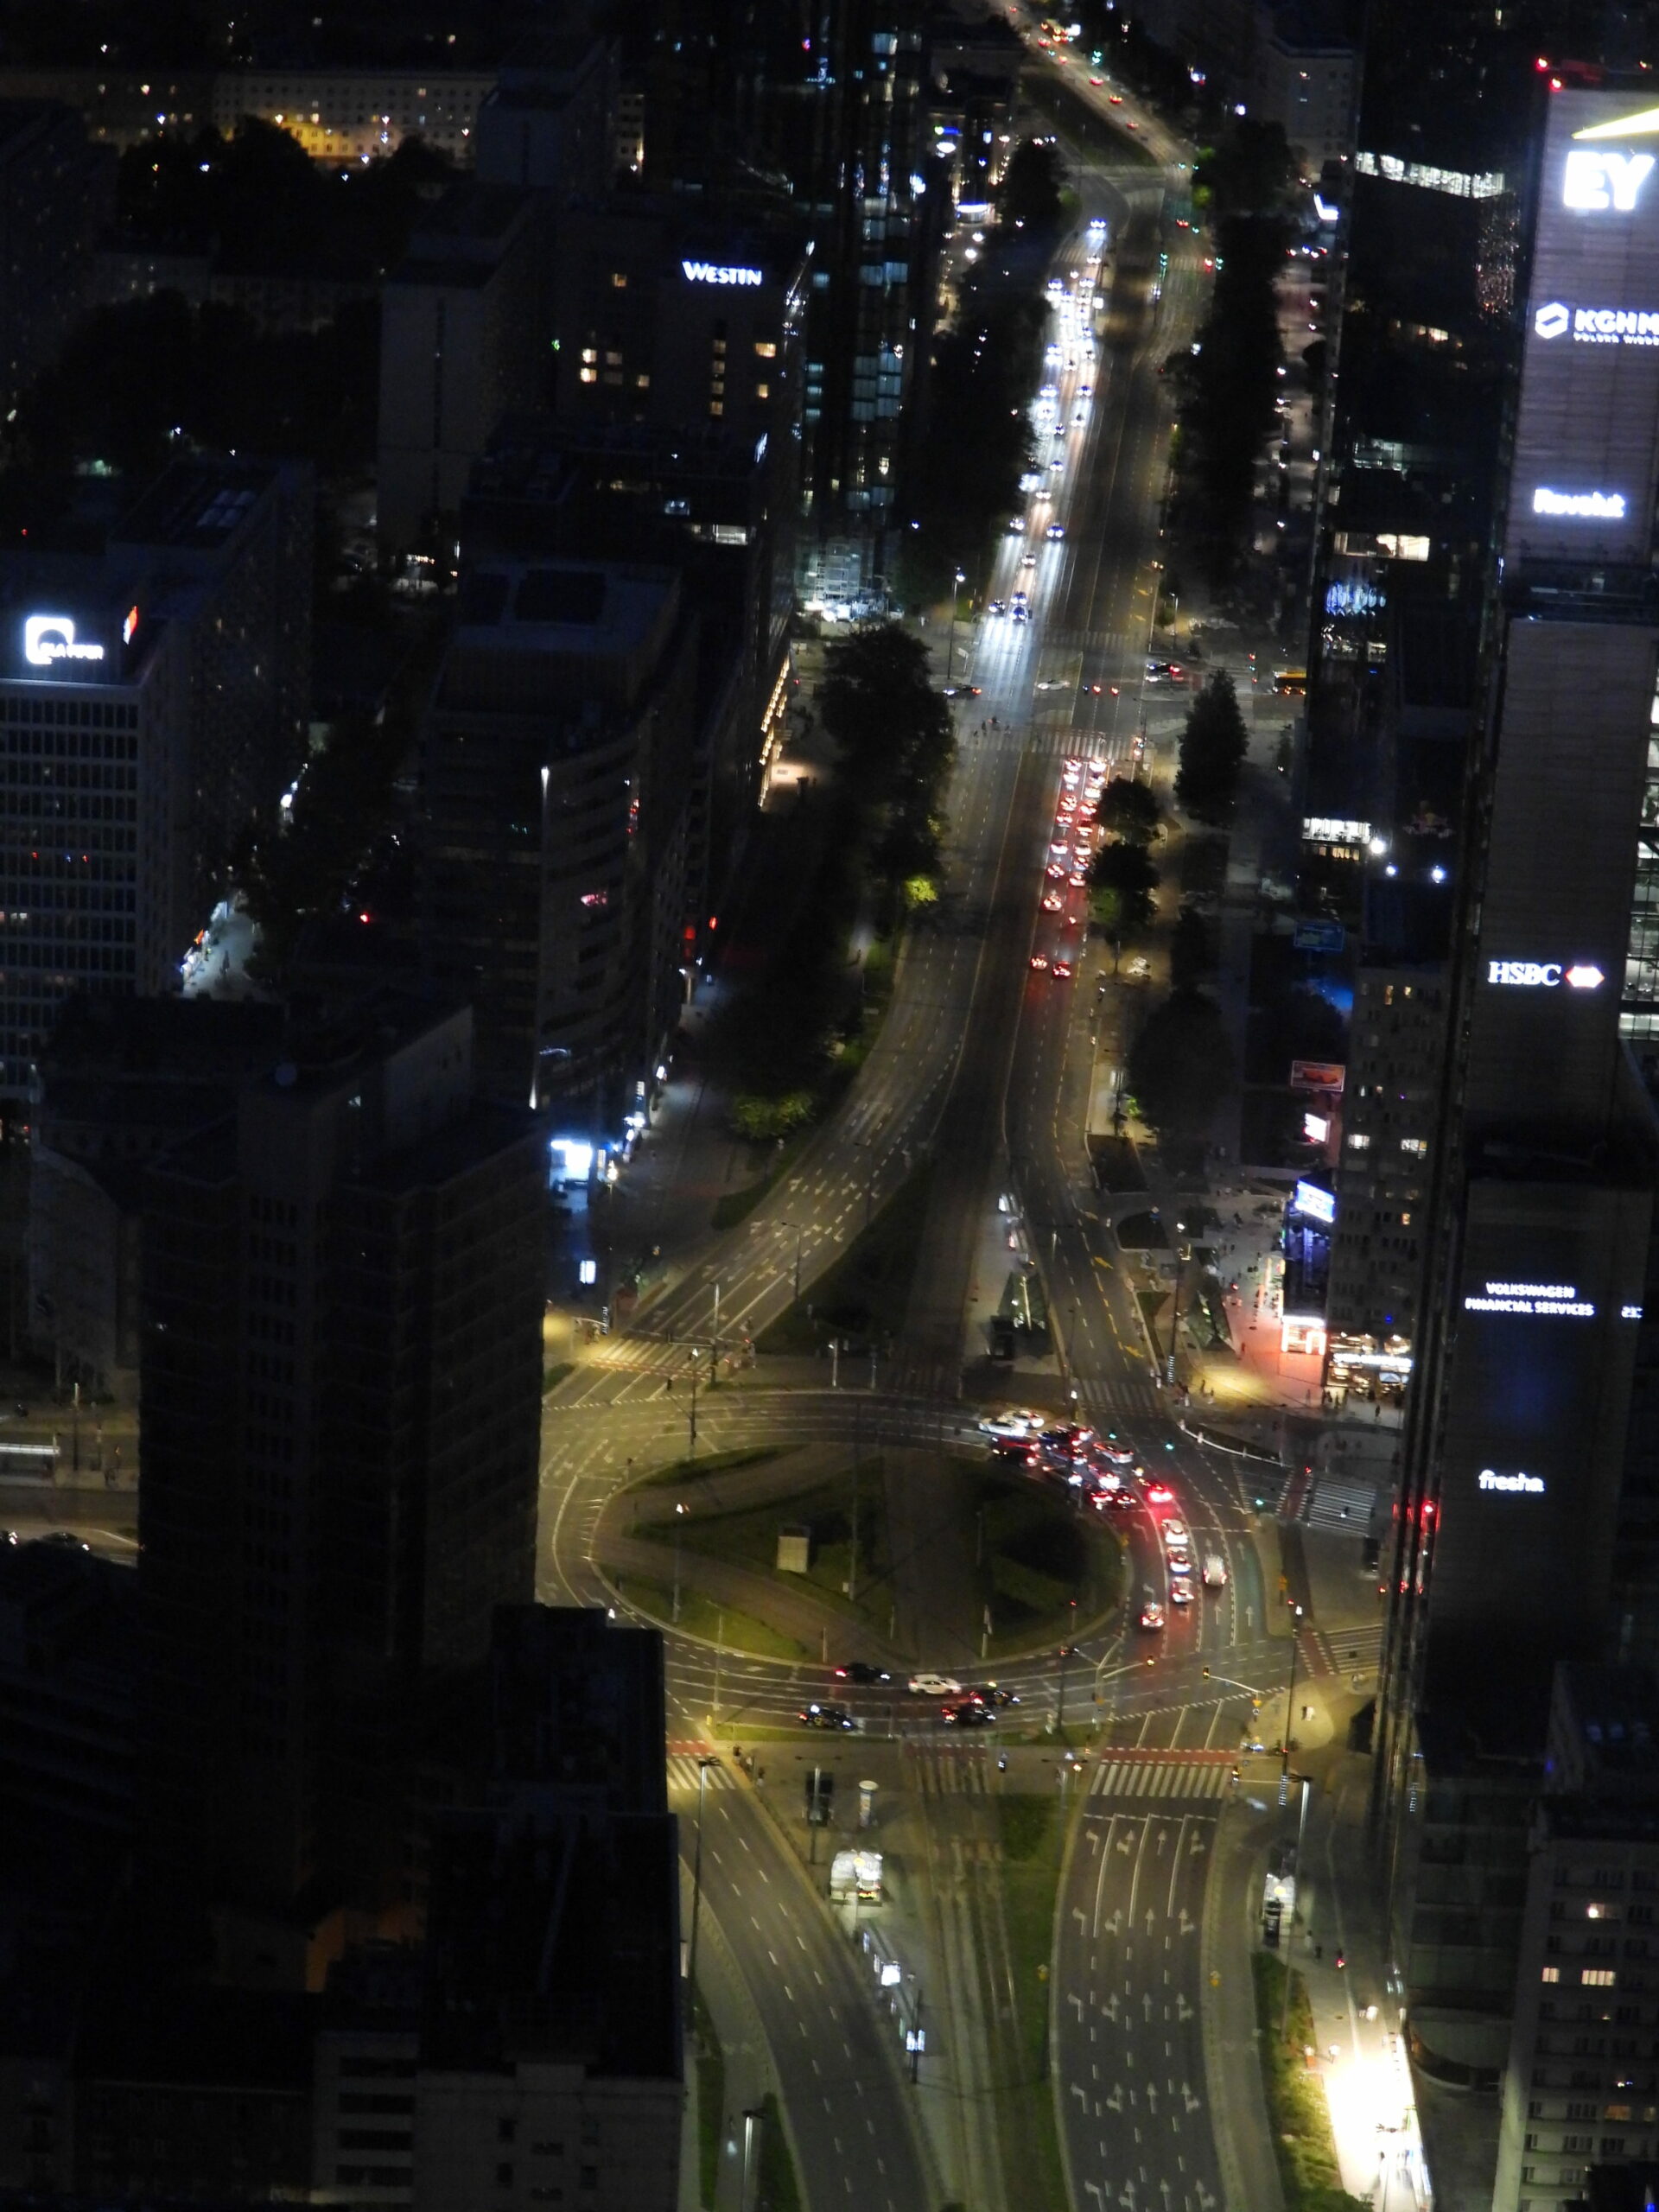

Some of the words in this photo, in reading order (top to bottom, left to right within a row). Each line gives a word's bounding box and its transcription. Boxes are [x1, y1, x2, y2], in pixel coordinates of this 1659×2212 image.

[1563, 151, 1655, 210] EY
[682, 261, 762, 286] WESTIN
[1574, 309, 1659, 335] KGHM
[1488, 961, 1561, 986] HSBC
[1486, 1282, 1575, 1299] VOLKSWAGEN
[1465, 1298, 1533, 1313] FINANCIAL
[1535, 1301, 1594, 1316] SERVICES
